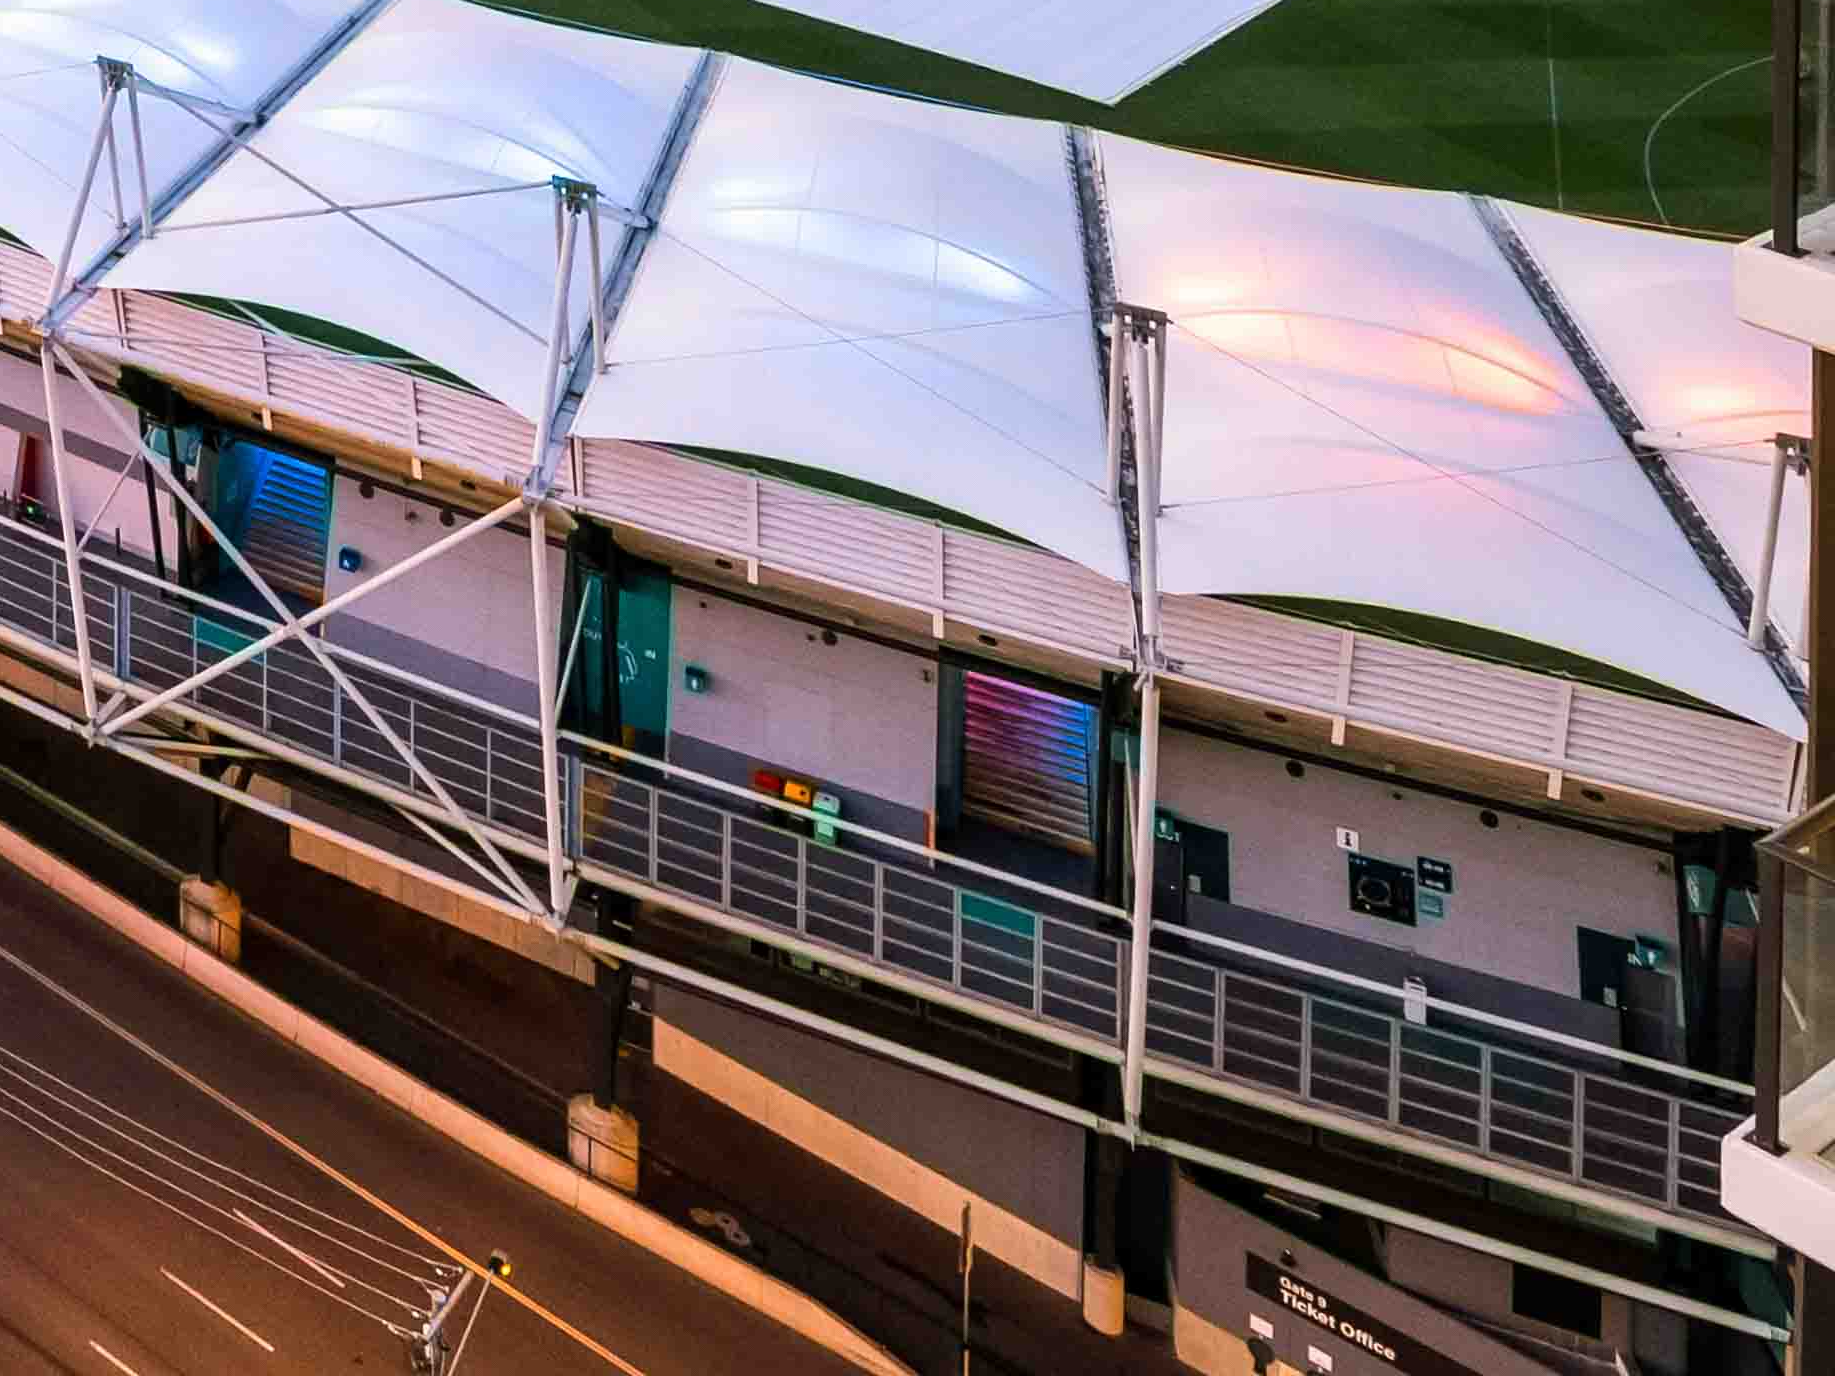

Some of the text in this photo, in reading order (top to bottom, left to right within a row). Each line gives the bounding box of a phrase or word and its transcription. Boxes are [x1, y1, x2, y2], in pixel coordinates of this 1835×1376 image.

[1279, 1275, 1314, 1302] Gate
[1279, 1288, 1396, 1361] Ticket Office
